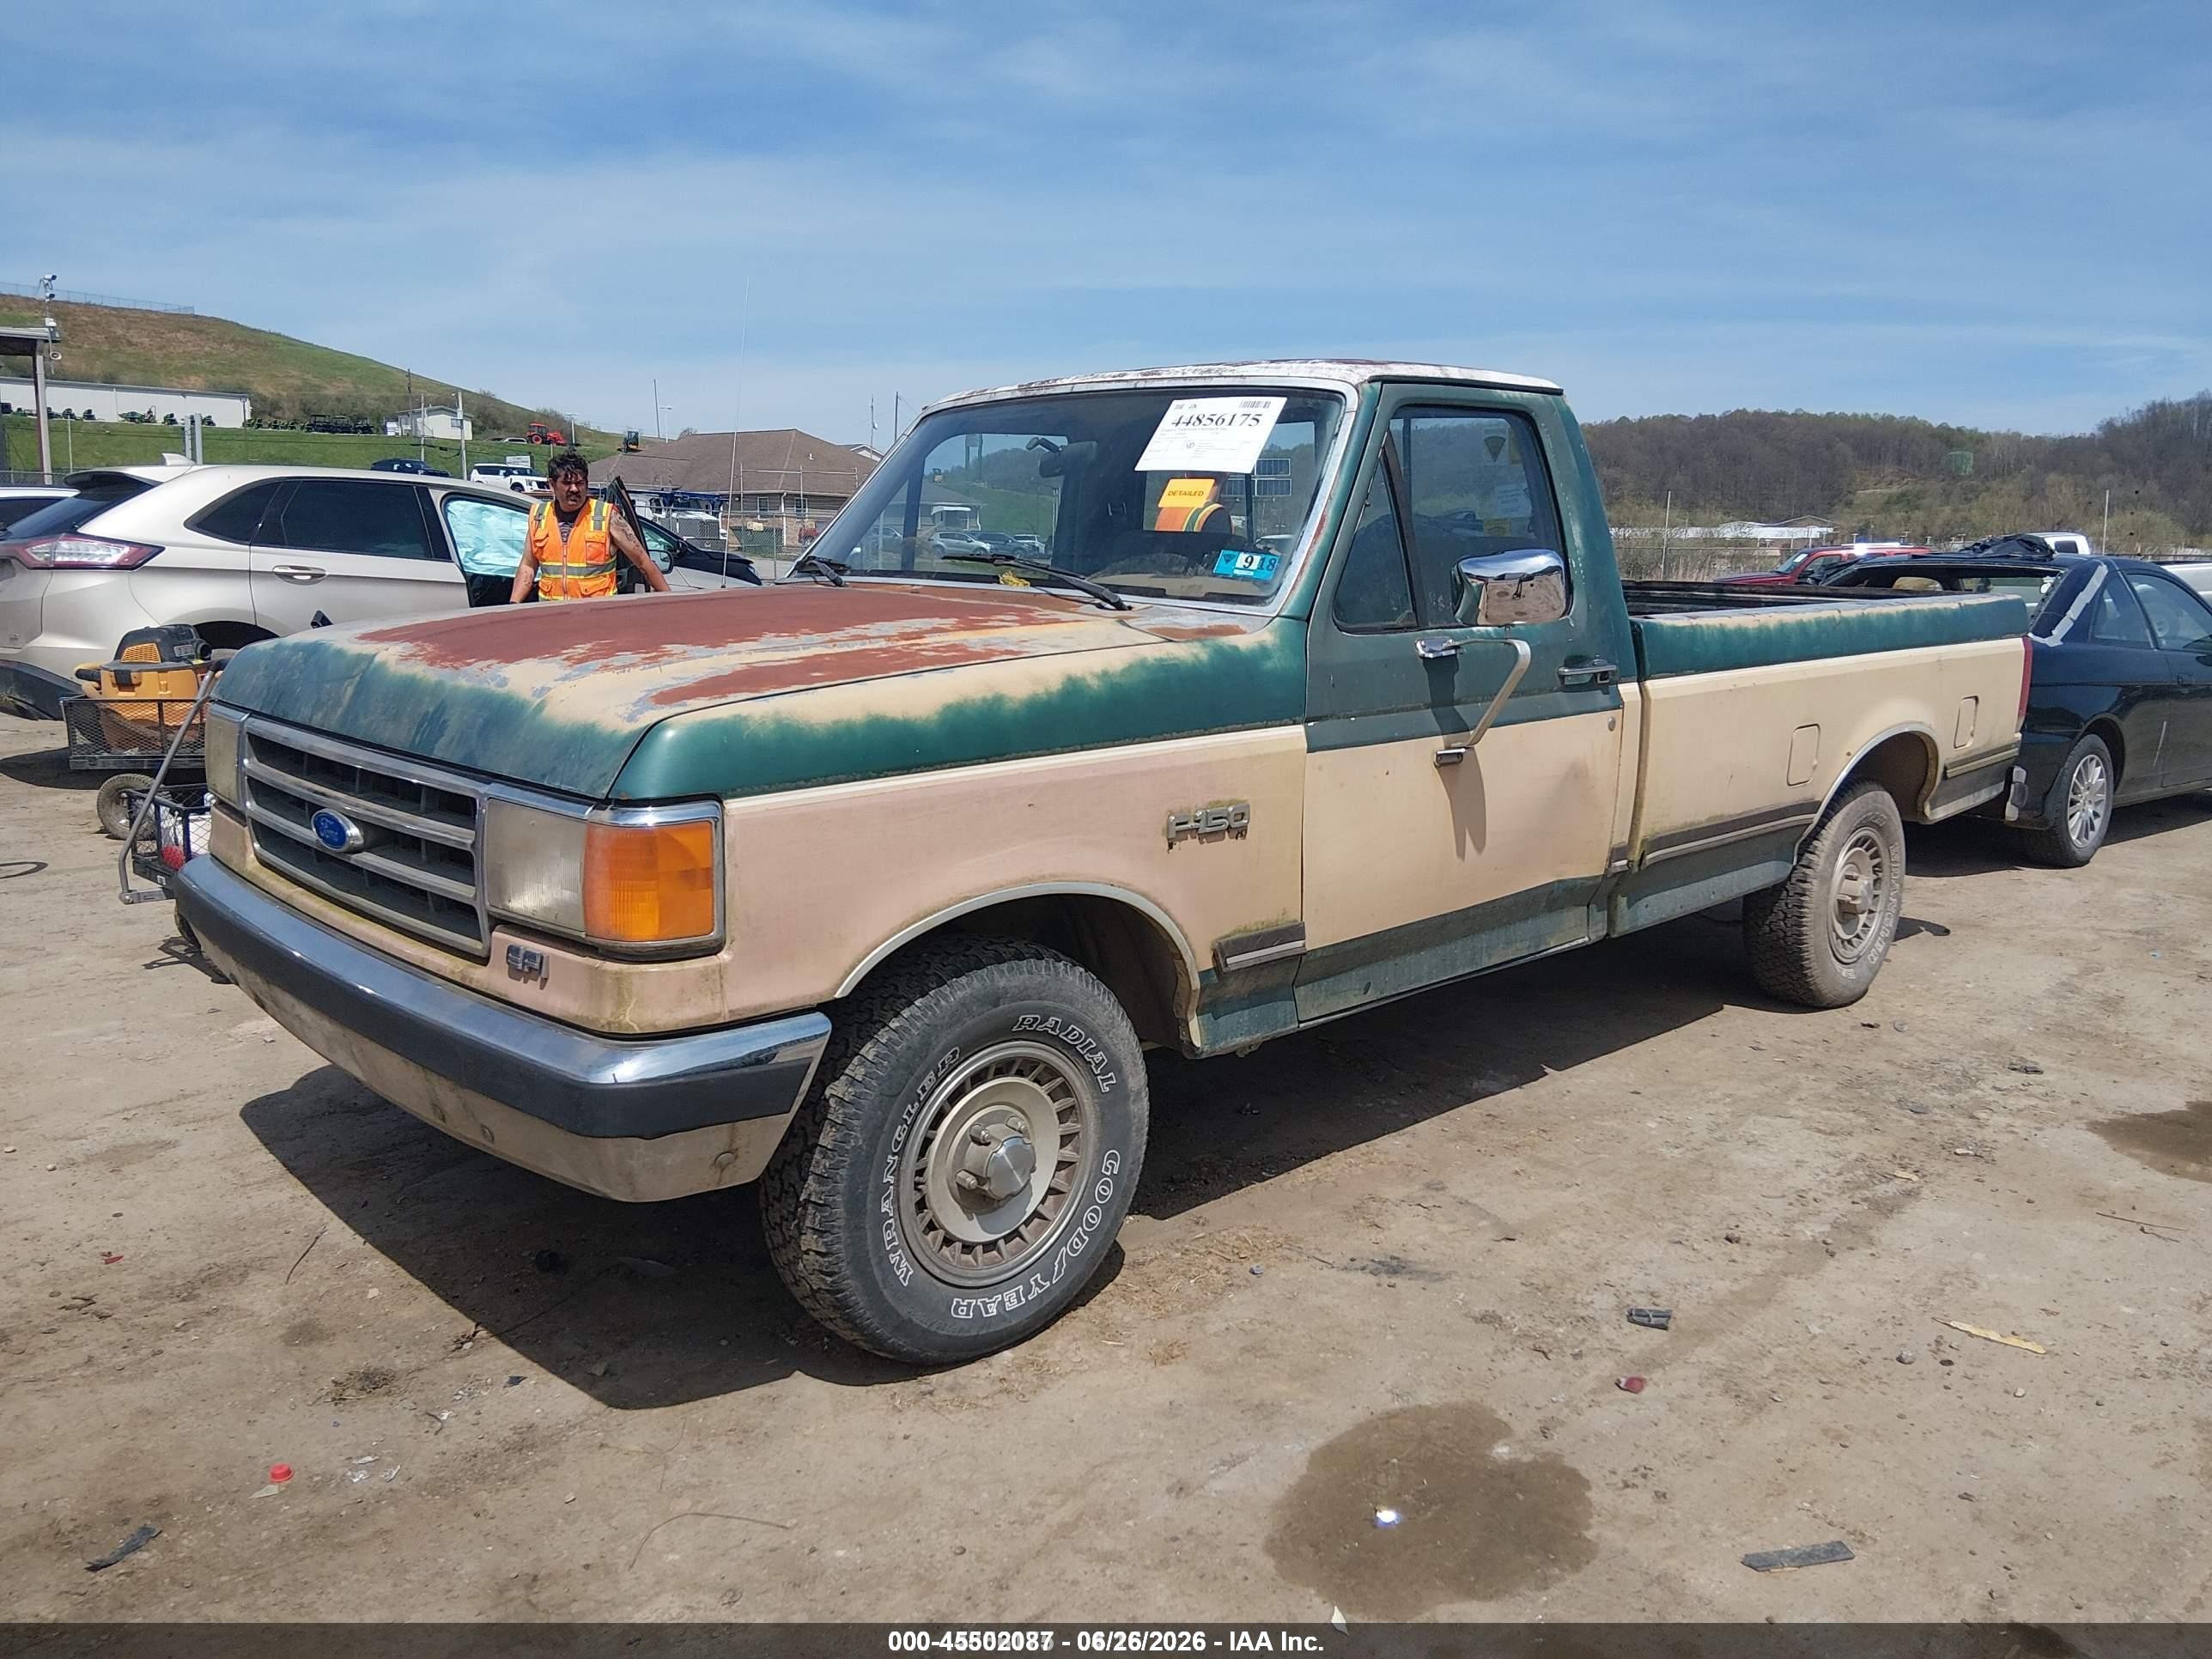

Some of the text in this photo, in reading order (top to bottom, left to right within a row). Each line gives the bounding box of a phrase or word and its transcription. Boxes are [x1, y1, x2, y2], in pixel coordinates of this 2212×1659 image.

[1171, 412, 1263, 428] 44856175
[1243, 555, 1277, 572] 9 18
[1167, 803, 1250, 839] F-150
[1011, 1014, 1116, 1094] RADIAL
[880, 1046, 961, 1286] WRANGLER
